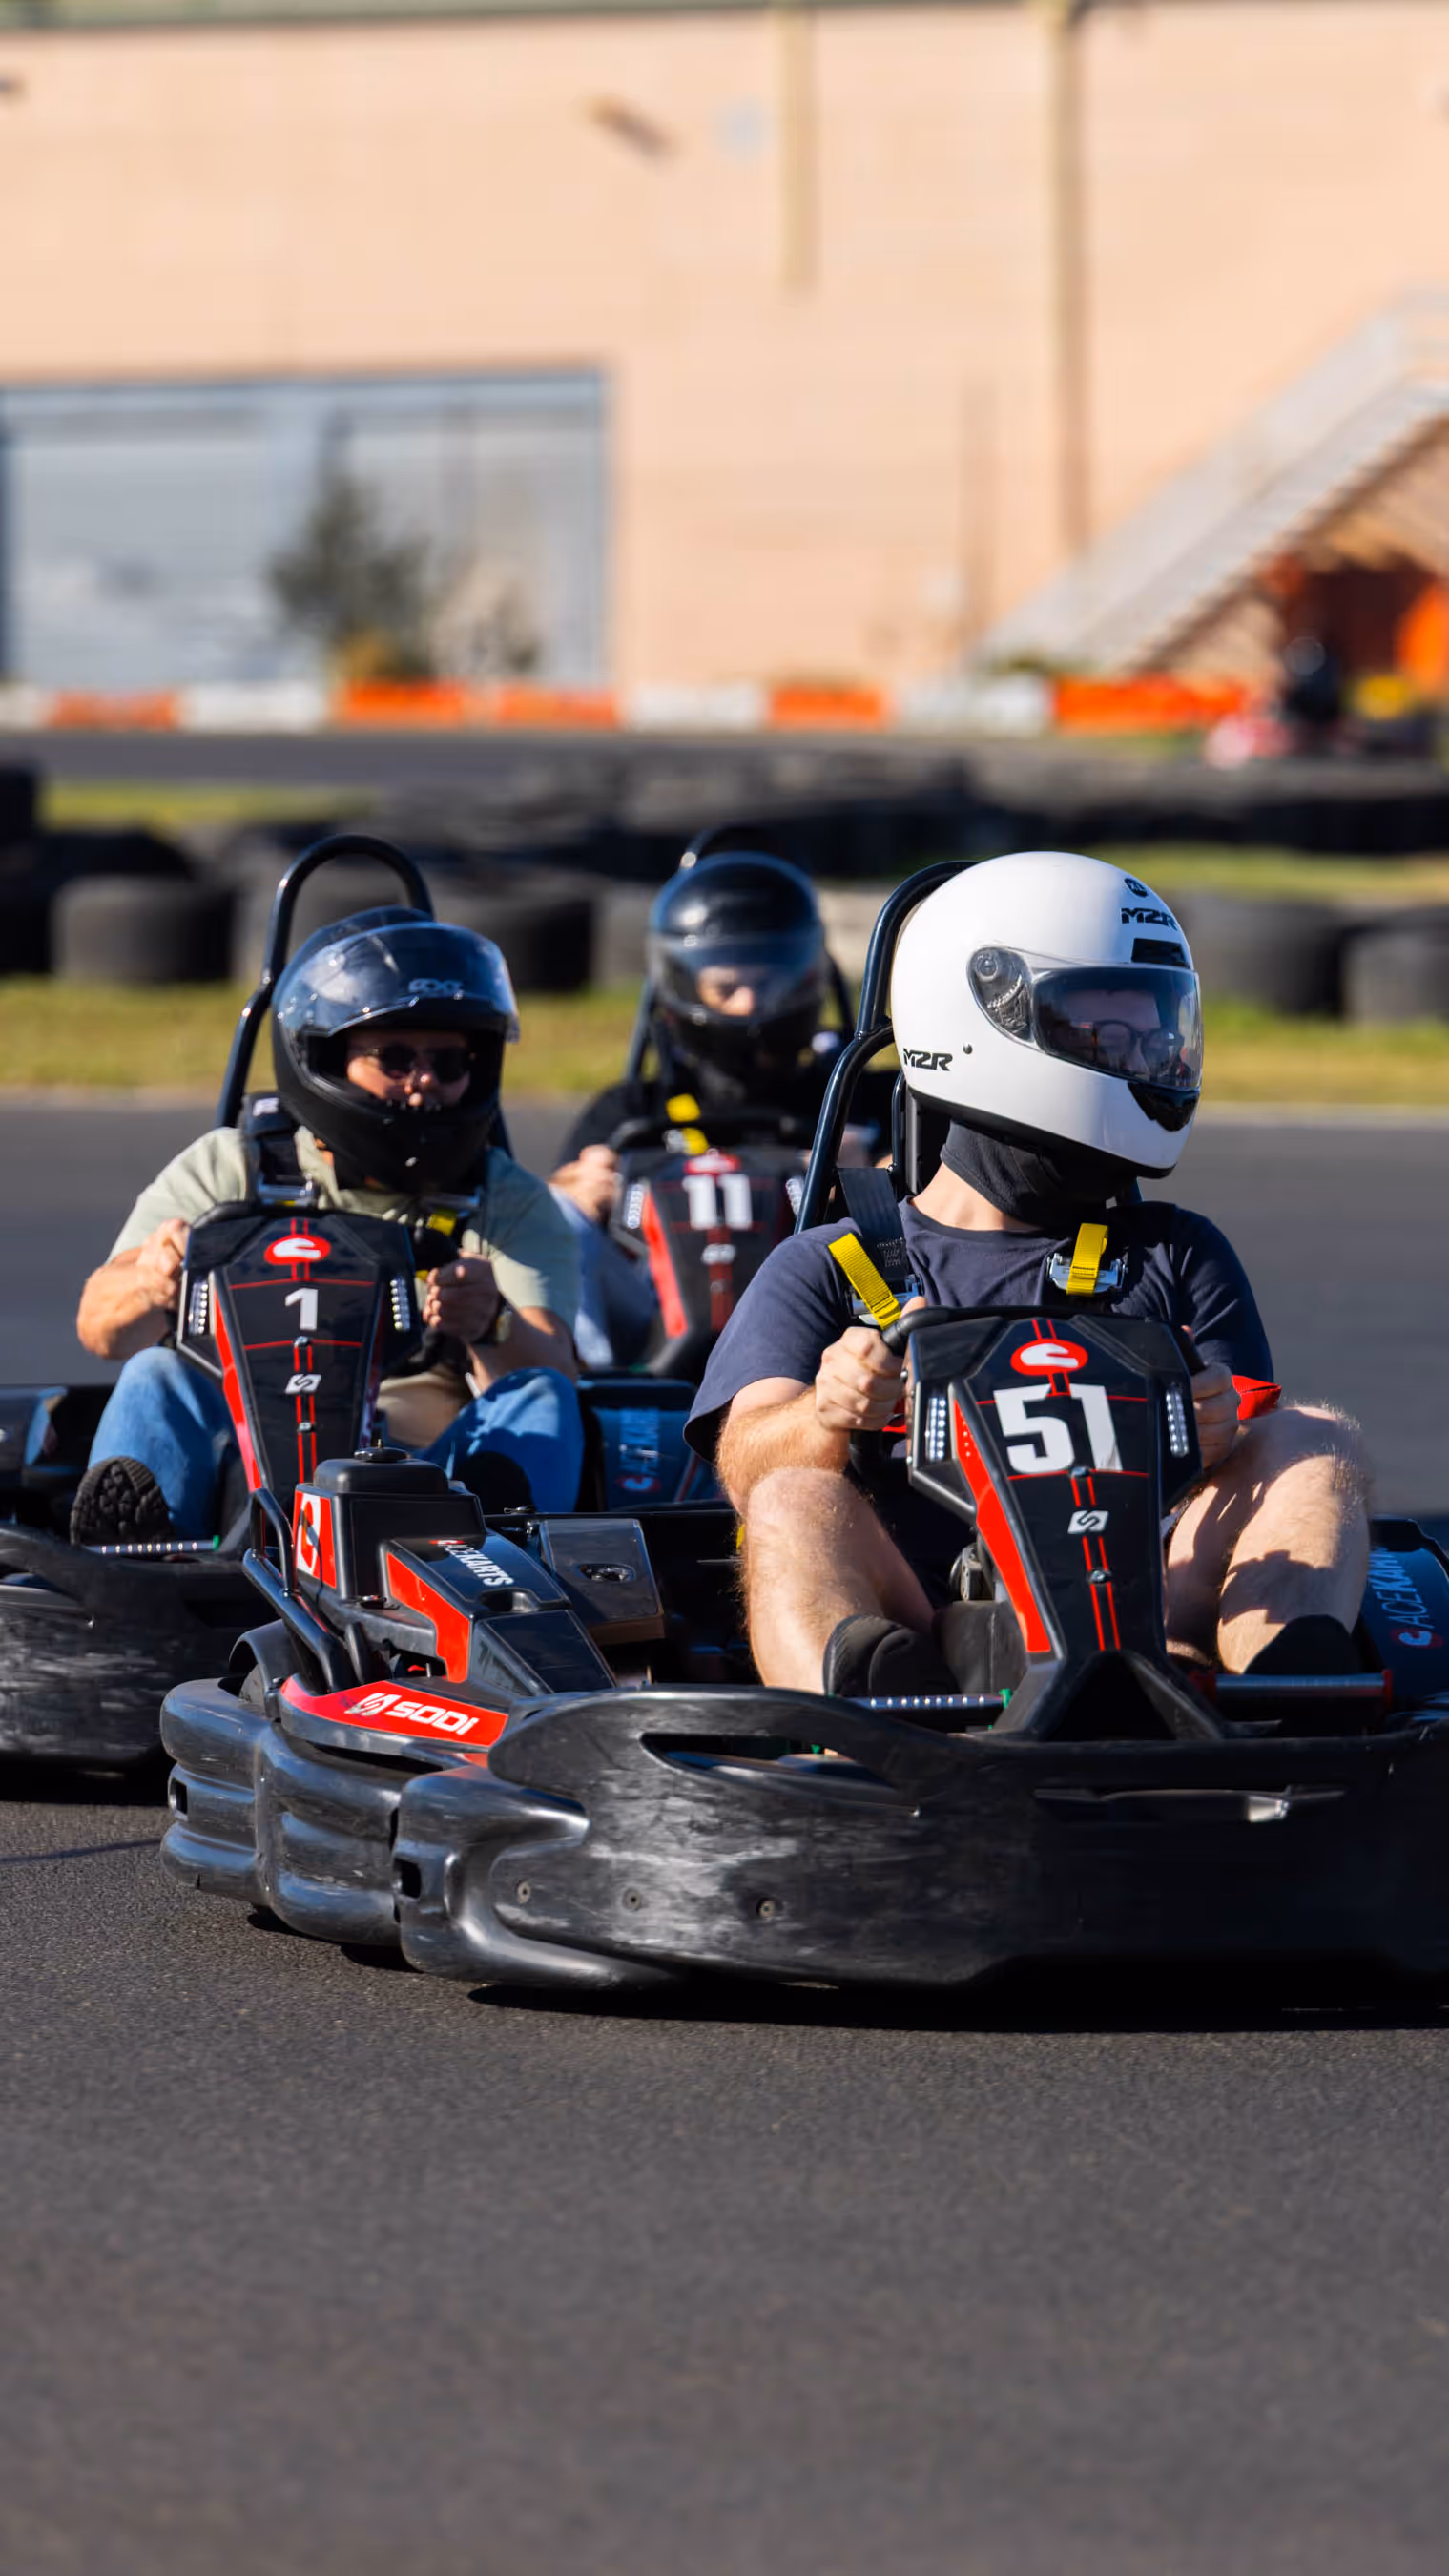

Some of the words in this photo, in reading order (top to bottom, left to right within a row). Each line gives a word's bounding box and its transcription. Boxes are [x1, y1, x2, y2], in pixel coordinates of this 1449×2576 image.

[1121, 907, 1178, 931] M2R
[902, 1048, 953, 1071] M2R
[682, 1173, 752, 1230] 11
[284, 1287, 319, 1331] 1
[993, 1382, 1123, 1474] 51
[384, 1701, 480, 1735] SODI
